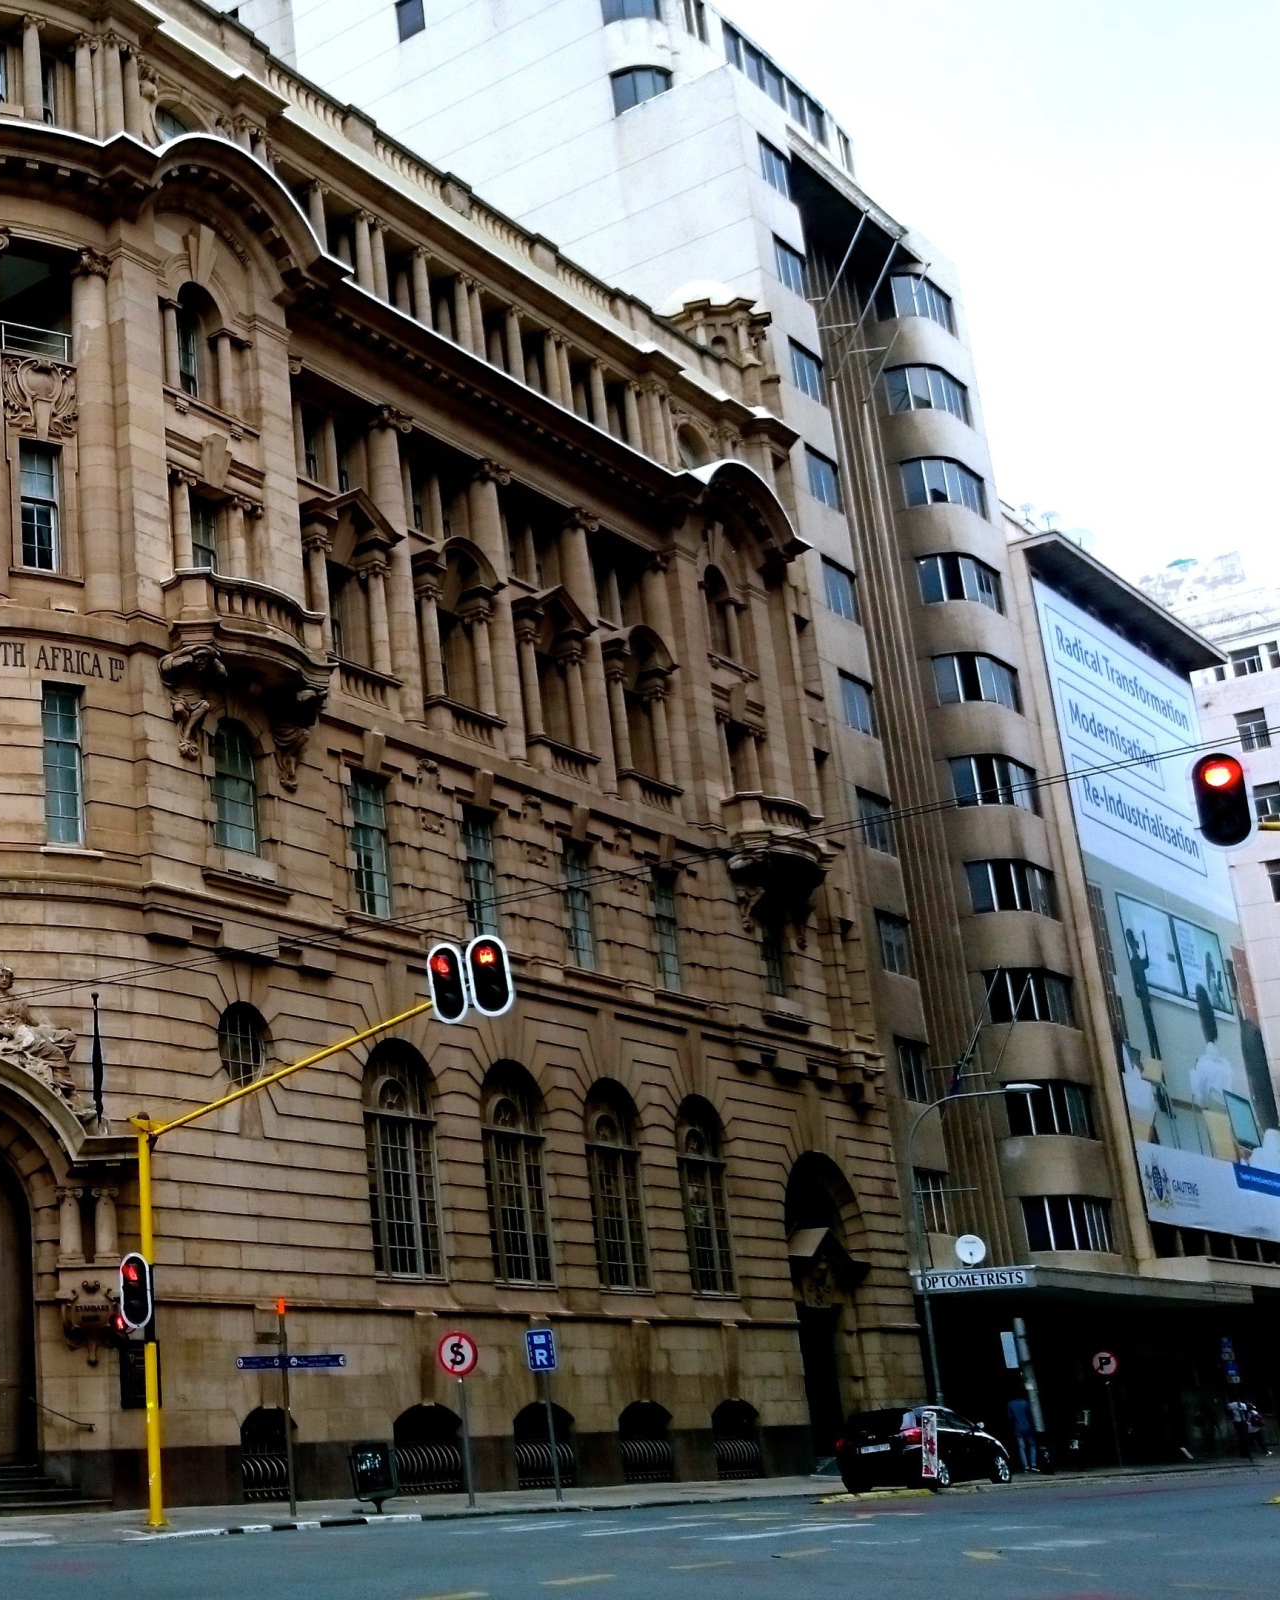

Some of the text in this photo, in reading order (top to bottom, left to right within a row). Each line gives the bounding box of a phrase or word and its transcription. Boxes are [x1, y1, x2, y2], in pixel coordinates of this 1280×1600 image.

[35, 646, 103, 678] AFRICA
[1055, 625, 1190, 732] Radical Transformation
[1068, 698, 1158, 773] Modernisation
[1082, 774, 1200, 859] Re-Industrialisation
[1172, 1180, 1199, 1196] GAUTENG
[450, 1343, 466, 1366] S
[535, 1349, 548, 1366] R
[1098, 1356, 1111, 1371] P
